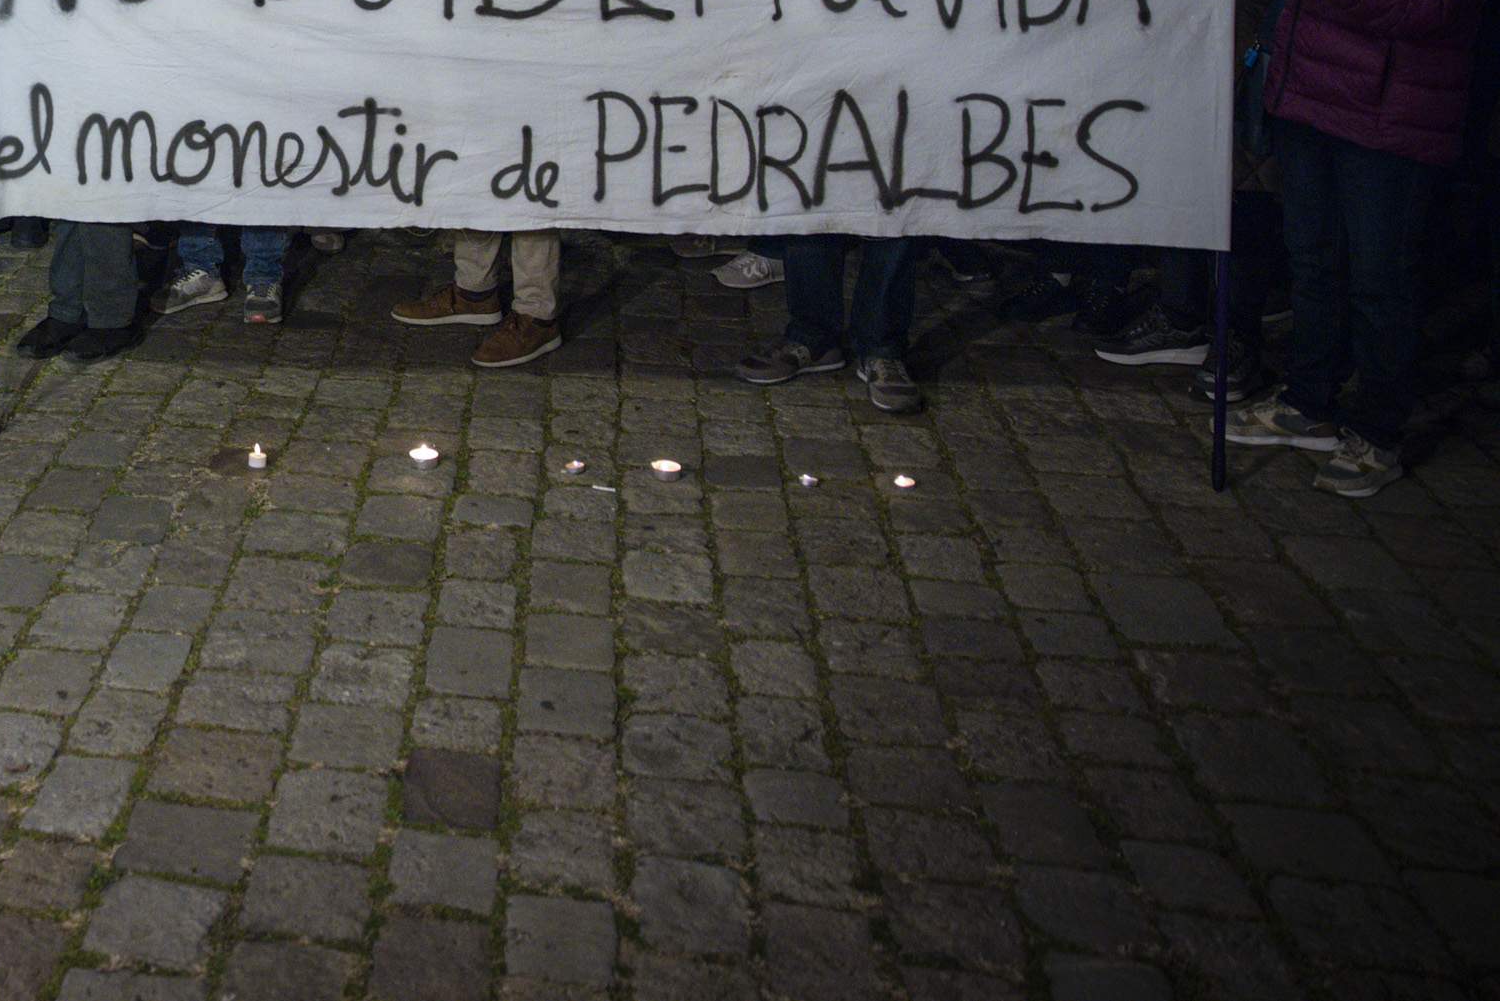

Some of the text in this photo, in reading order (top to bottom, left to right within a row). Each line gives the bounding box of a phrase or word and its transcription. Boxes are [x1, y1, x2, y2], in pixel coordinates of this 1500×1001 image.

[76, 98, 458, 206] monestir
[491, 125, 559, 208] de
[586, 90, 1146, 214] PEDRALBES
